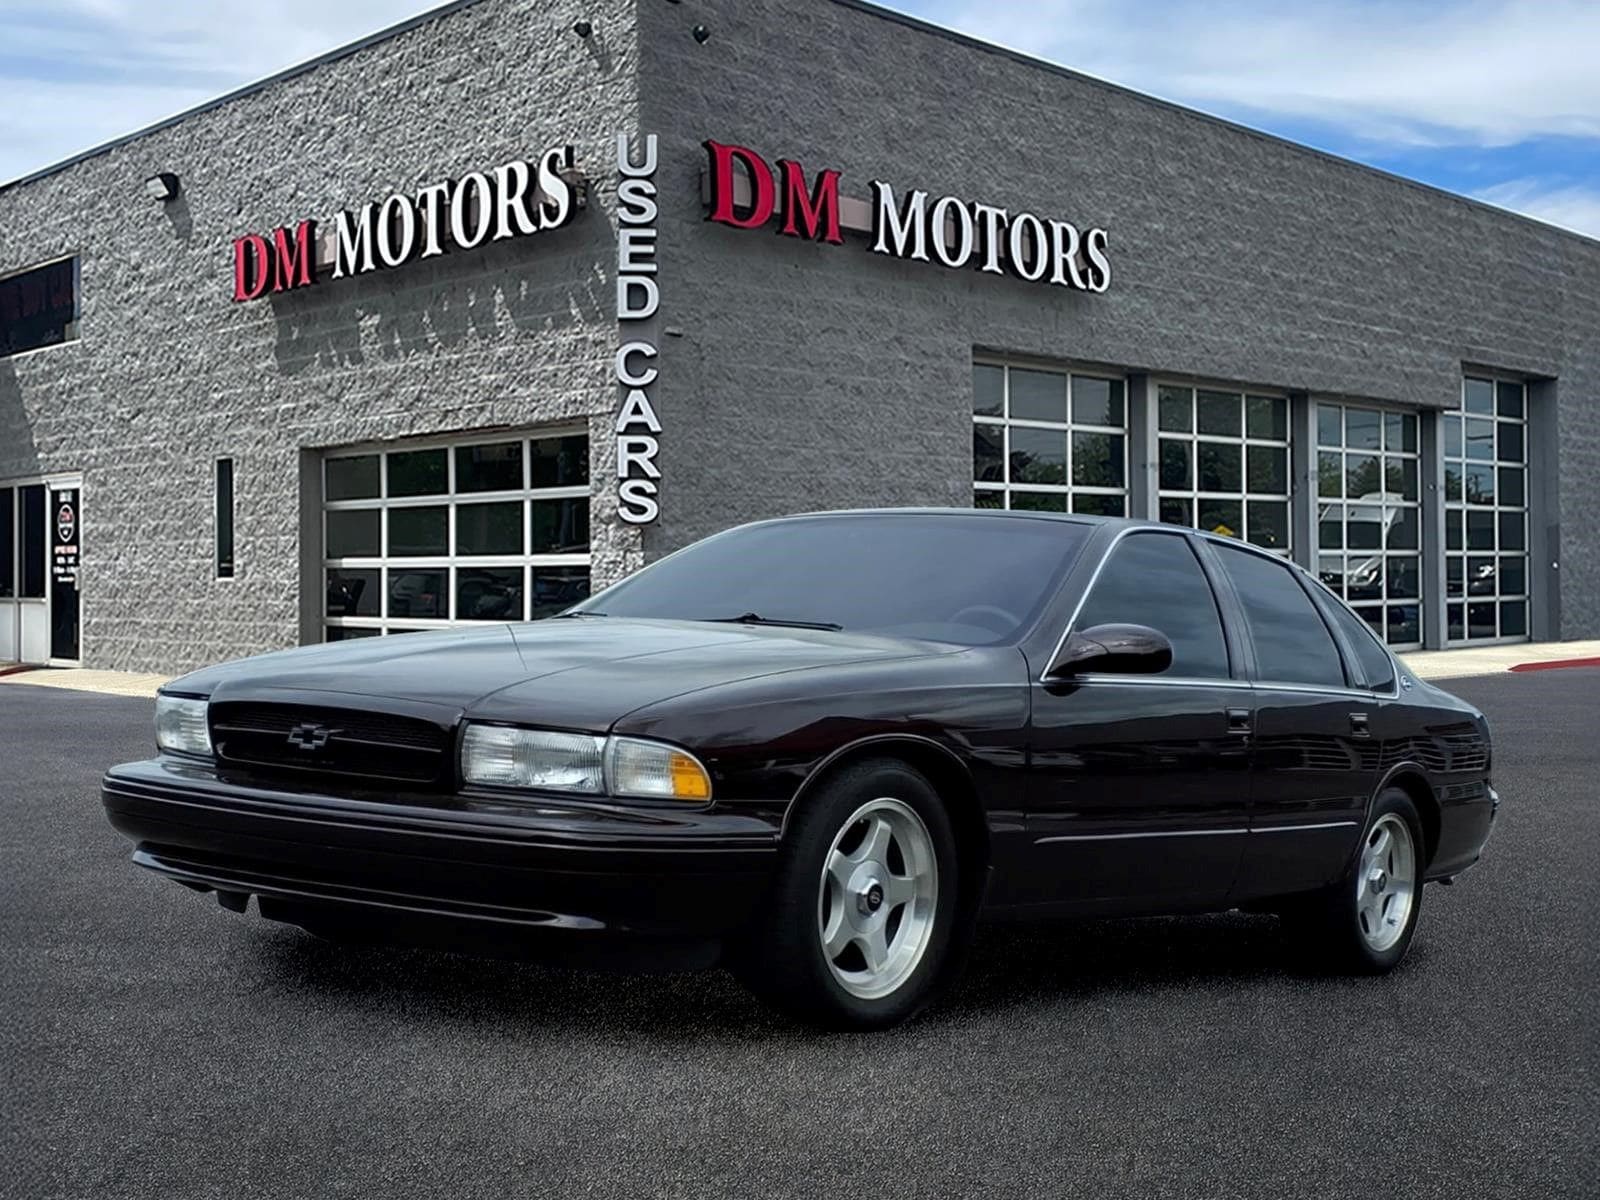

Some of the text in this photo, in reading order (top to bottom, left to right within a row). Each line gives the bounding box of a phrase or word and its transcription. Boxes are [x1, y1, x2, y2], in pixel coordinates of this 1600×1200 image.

[232, 145, 573, 302] DM MOTORS
[707, 139, 1111, 293] DM MOTORS
[616, 133, 662, 525] USED CARS
